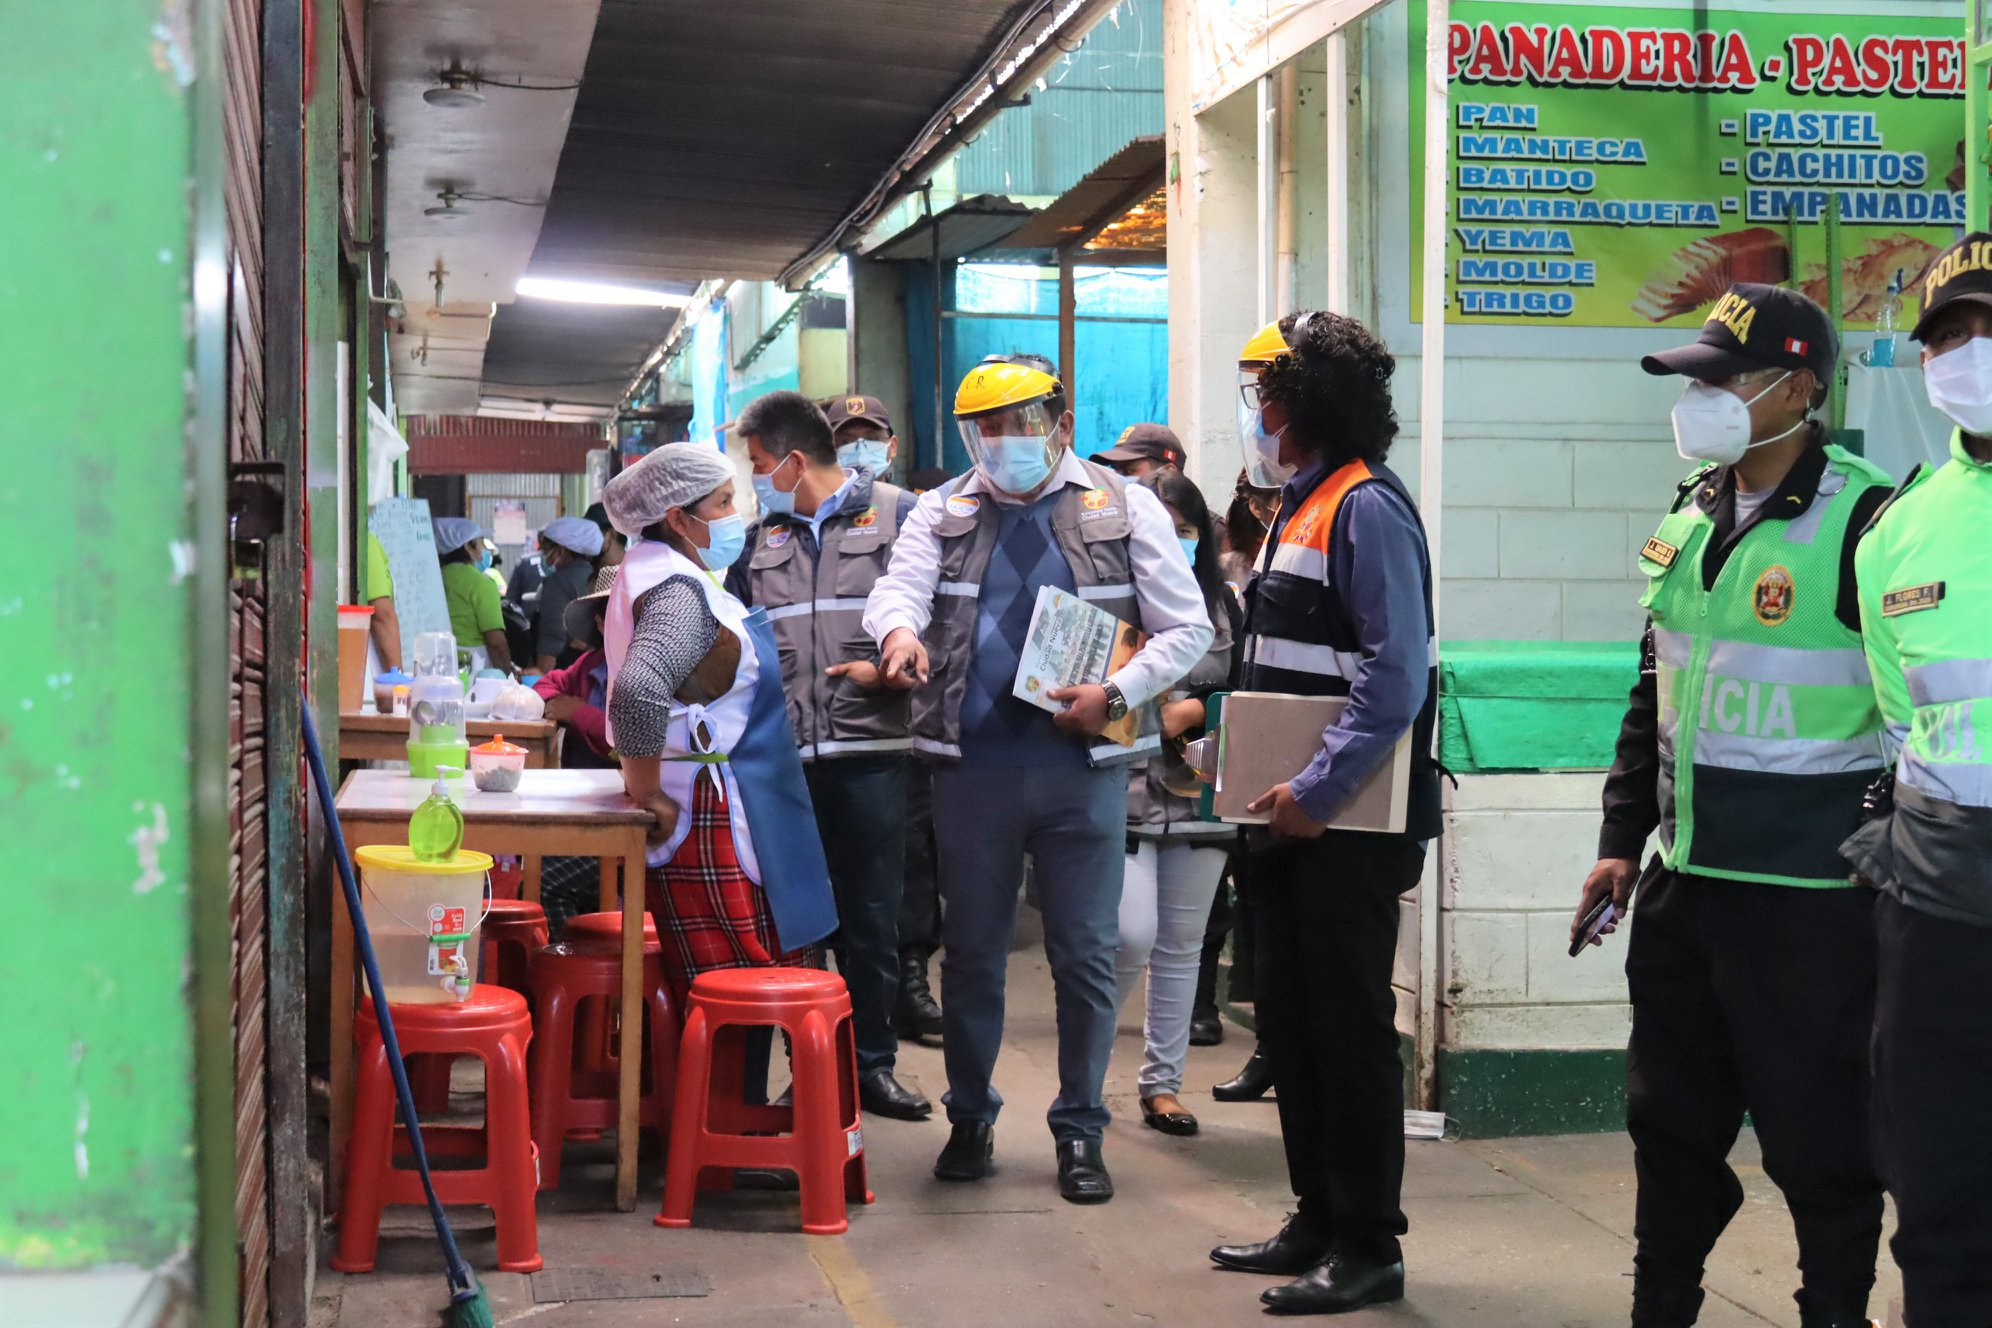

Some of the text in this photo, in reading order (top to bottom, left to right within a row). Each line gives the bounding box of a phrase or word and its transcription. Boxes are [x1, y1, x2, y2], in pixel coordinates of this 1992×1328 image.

[1447, 21, 1760, 88] PANADERIA
[1788, 33, 1966, 94] PASTE
[1459, 103, 1538, 127] PAN
[1746, 108, 1882, 146] PASTEL
[1459, 135, 1647, 162] MANTECA
[1459, 165, 1596, 191] BATIDO
[1746, 149, 1928, 185] CACHITOS
[1459, 196, 1719, 224] MARRAQUETA
[1460, 227, 1574, 252] YEMA
[1459, 259, 1596, 284] MOLDE
[1459, 289, 1575, 314] TRIGO
